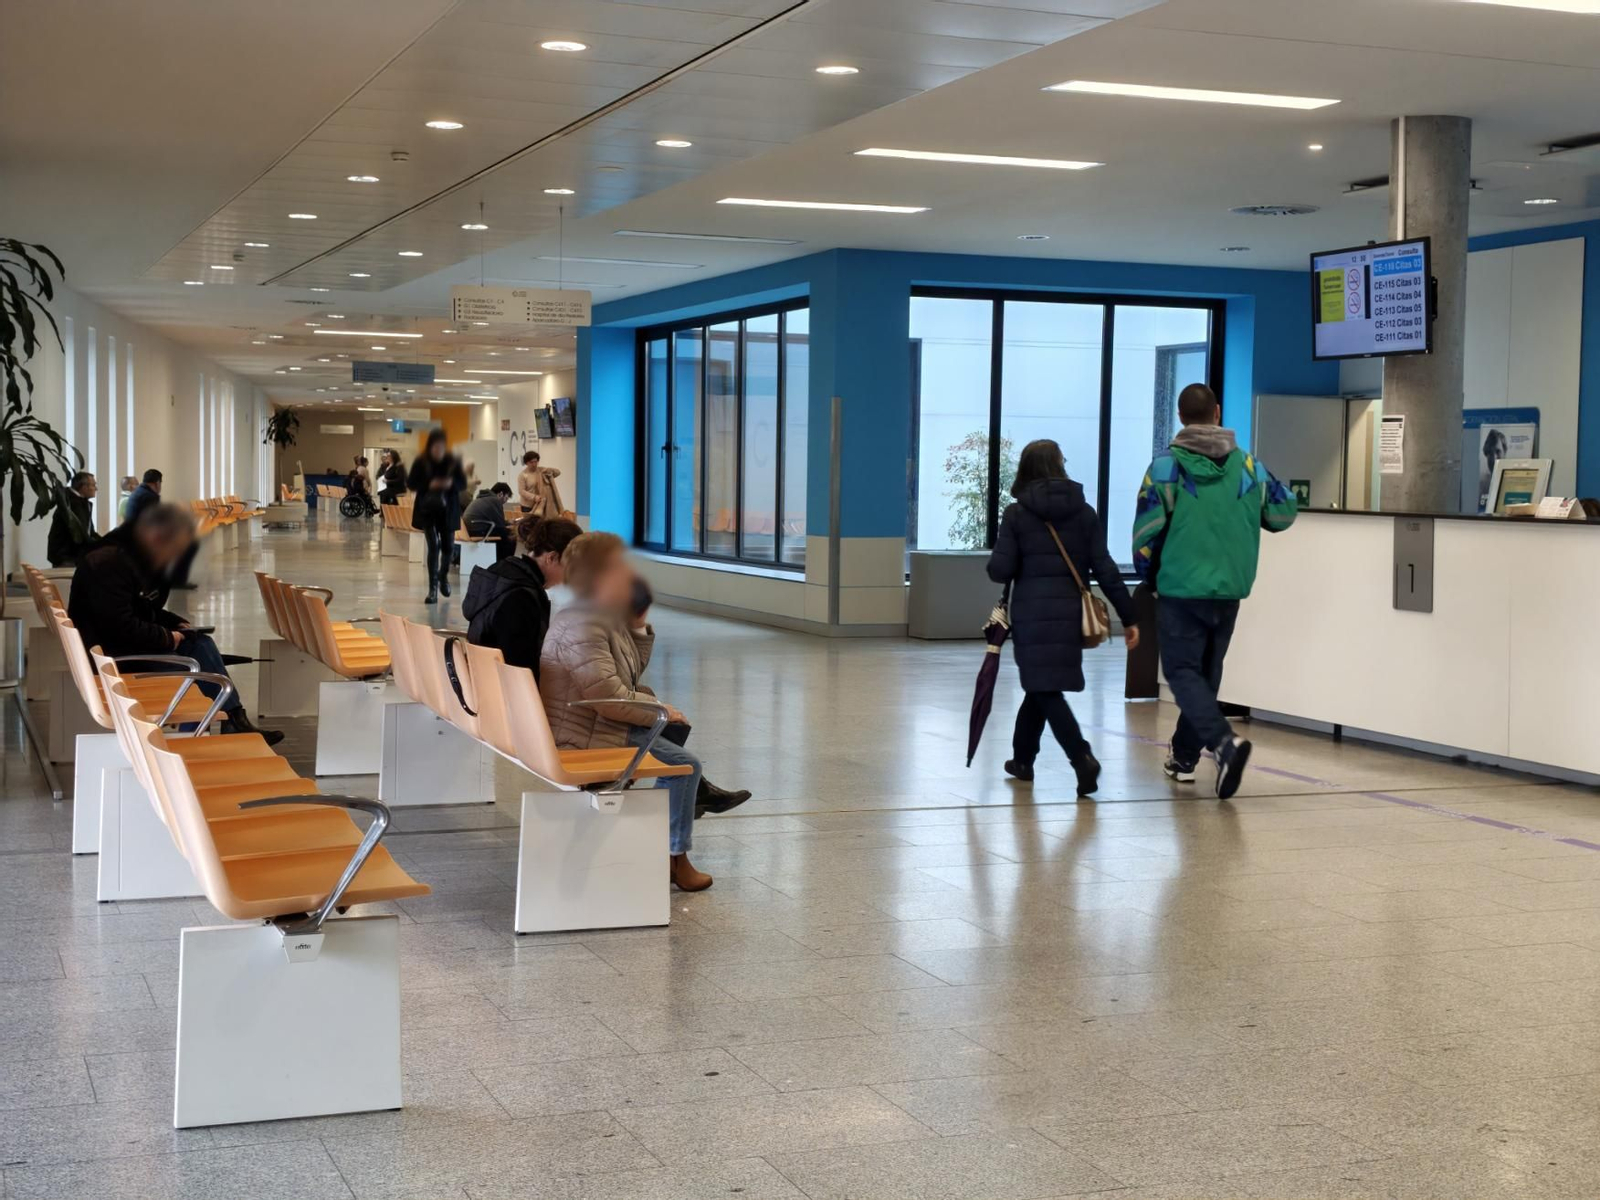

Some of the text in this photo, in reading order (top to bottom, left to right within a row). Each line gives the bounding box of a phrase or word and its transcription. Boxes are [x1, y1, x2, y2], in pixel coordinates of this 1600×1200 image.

[1374, 277, 1421, 290] CE-115 Citas 03
[1375, 290, 1421, 302] CE-114 Citas 04
[1375, 303, 1422, 316] CE-113 Citas 05
[1375, 316, 1422, 329] CE-112 Citas 03
[1375, 330, 1422, 342] CE-111 Citas 01
[510, 430, 527, 466] C3
[1408, 563, 1415, 594] 1
